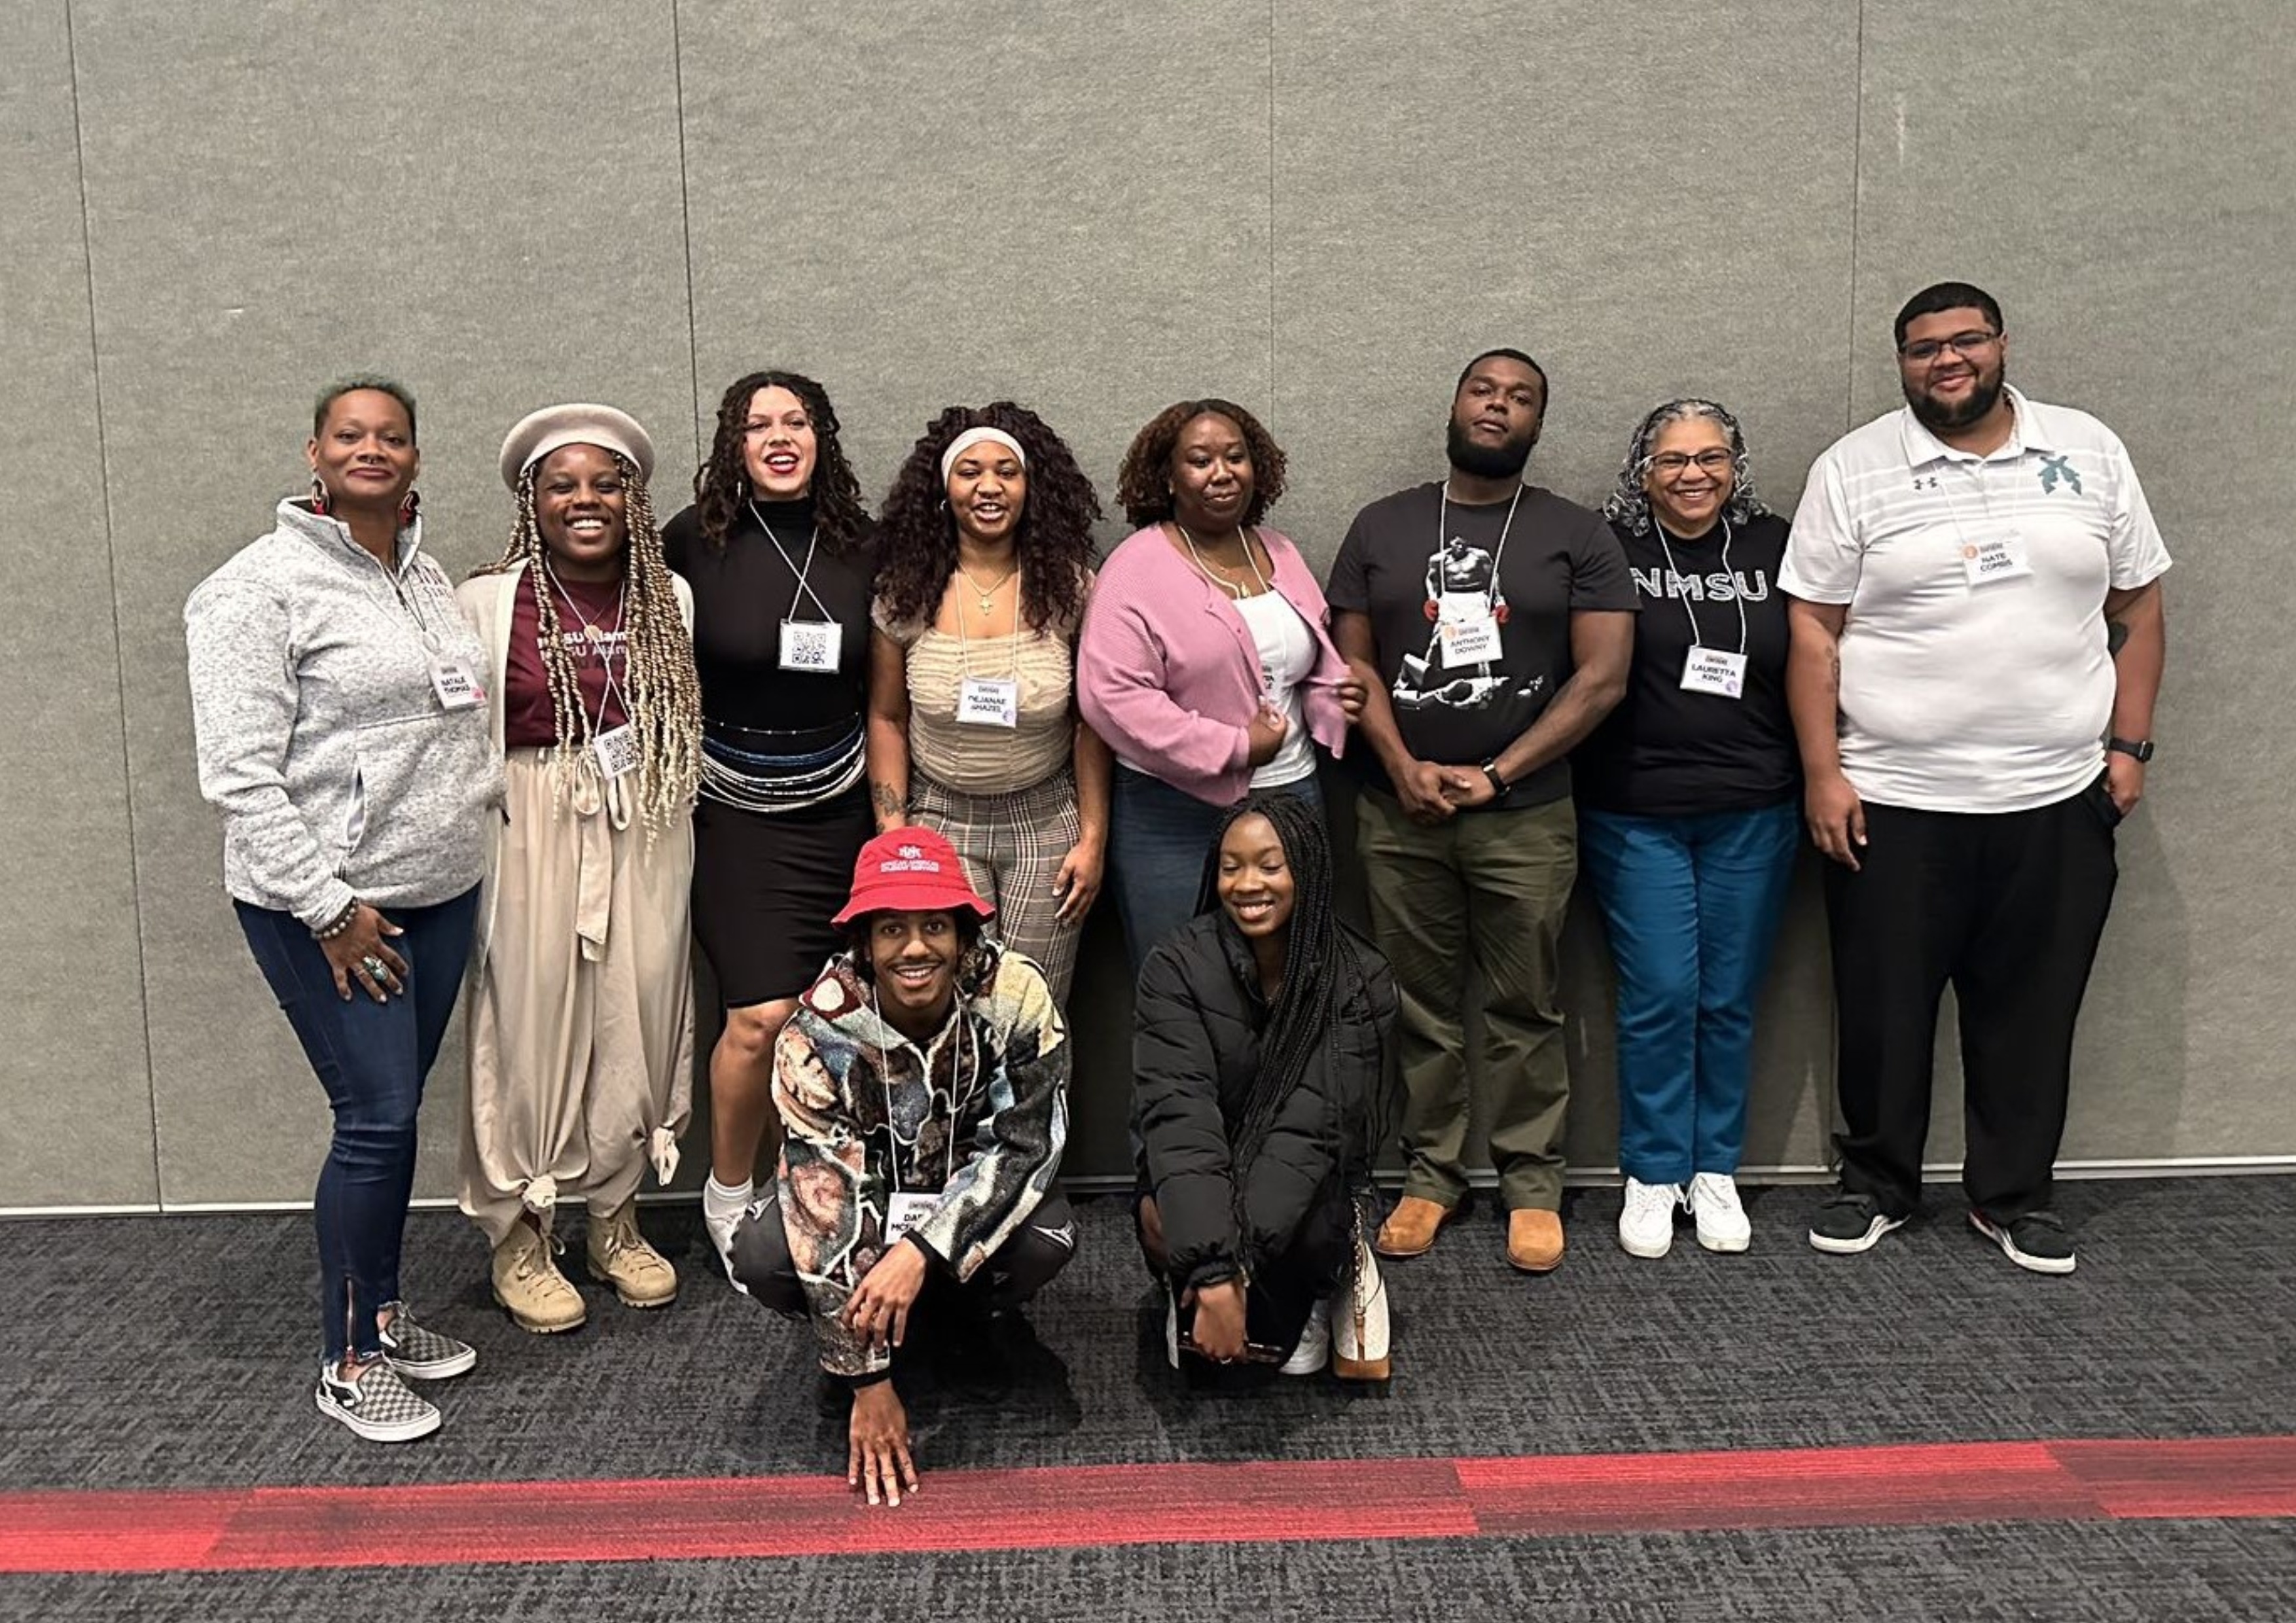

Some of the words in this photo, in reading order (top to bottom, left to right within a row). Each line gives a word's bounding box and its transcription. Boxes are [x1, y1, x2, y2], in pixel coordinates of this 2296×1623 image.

[1981, 552, 2006, 563] NATE
[1629, 567, 1767, 601] NMSU
[1450, 635, 1490, 648] ANTHONY
[1691, 663, 1736, 677] LAURETTA
[1702, 674, 1723, 683] KING
